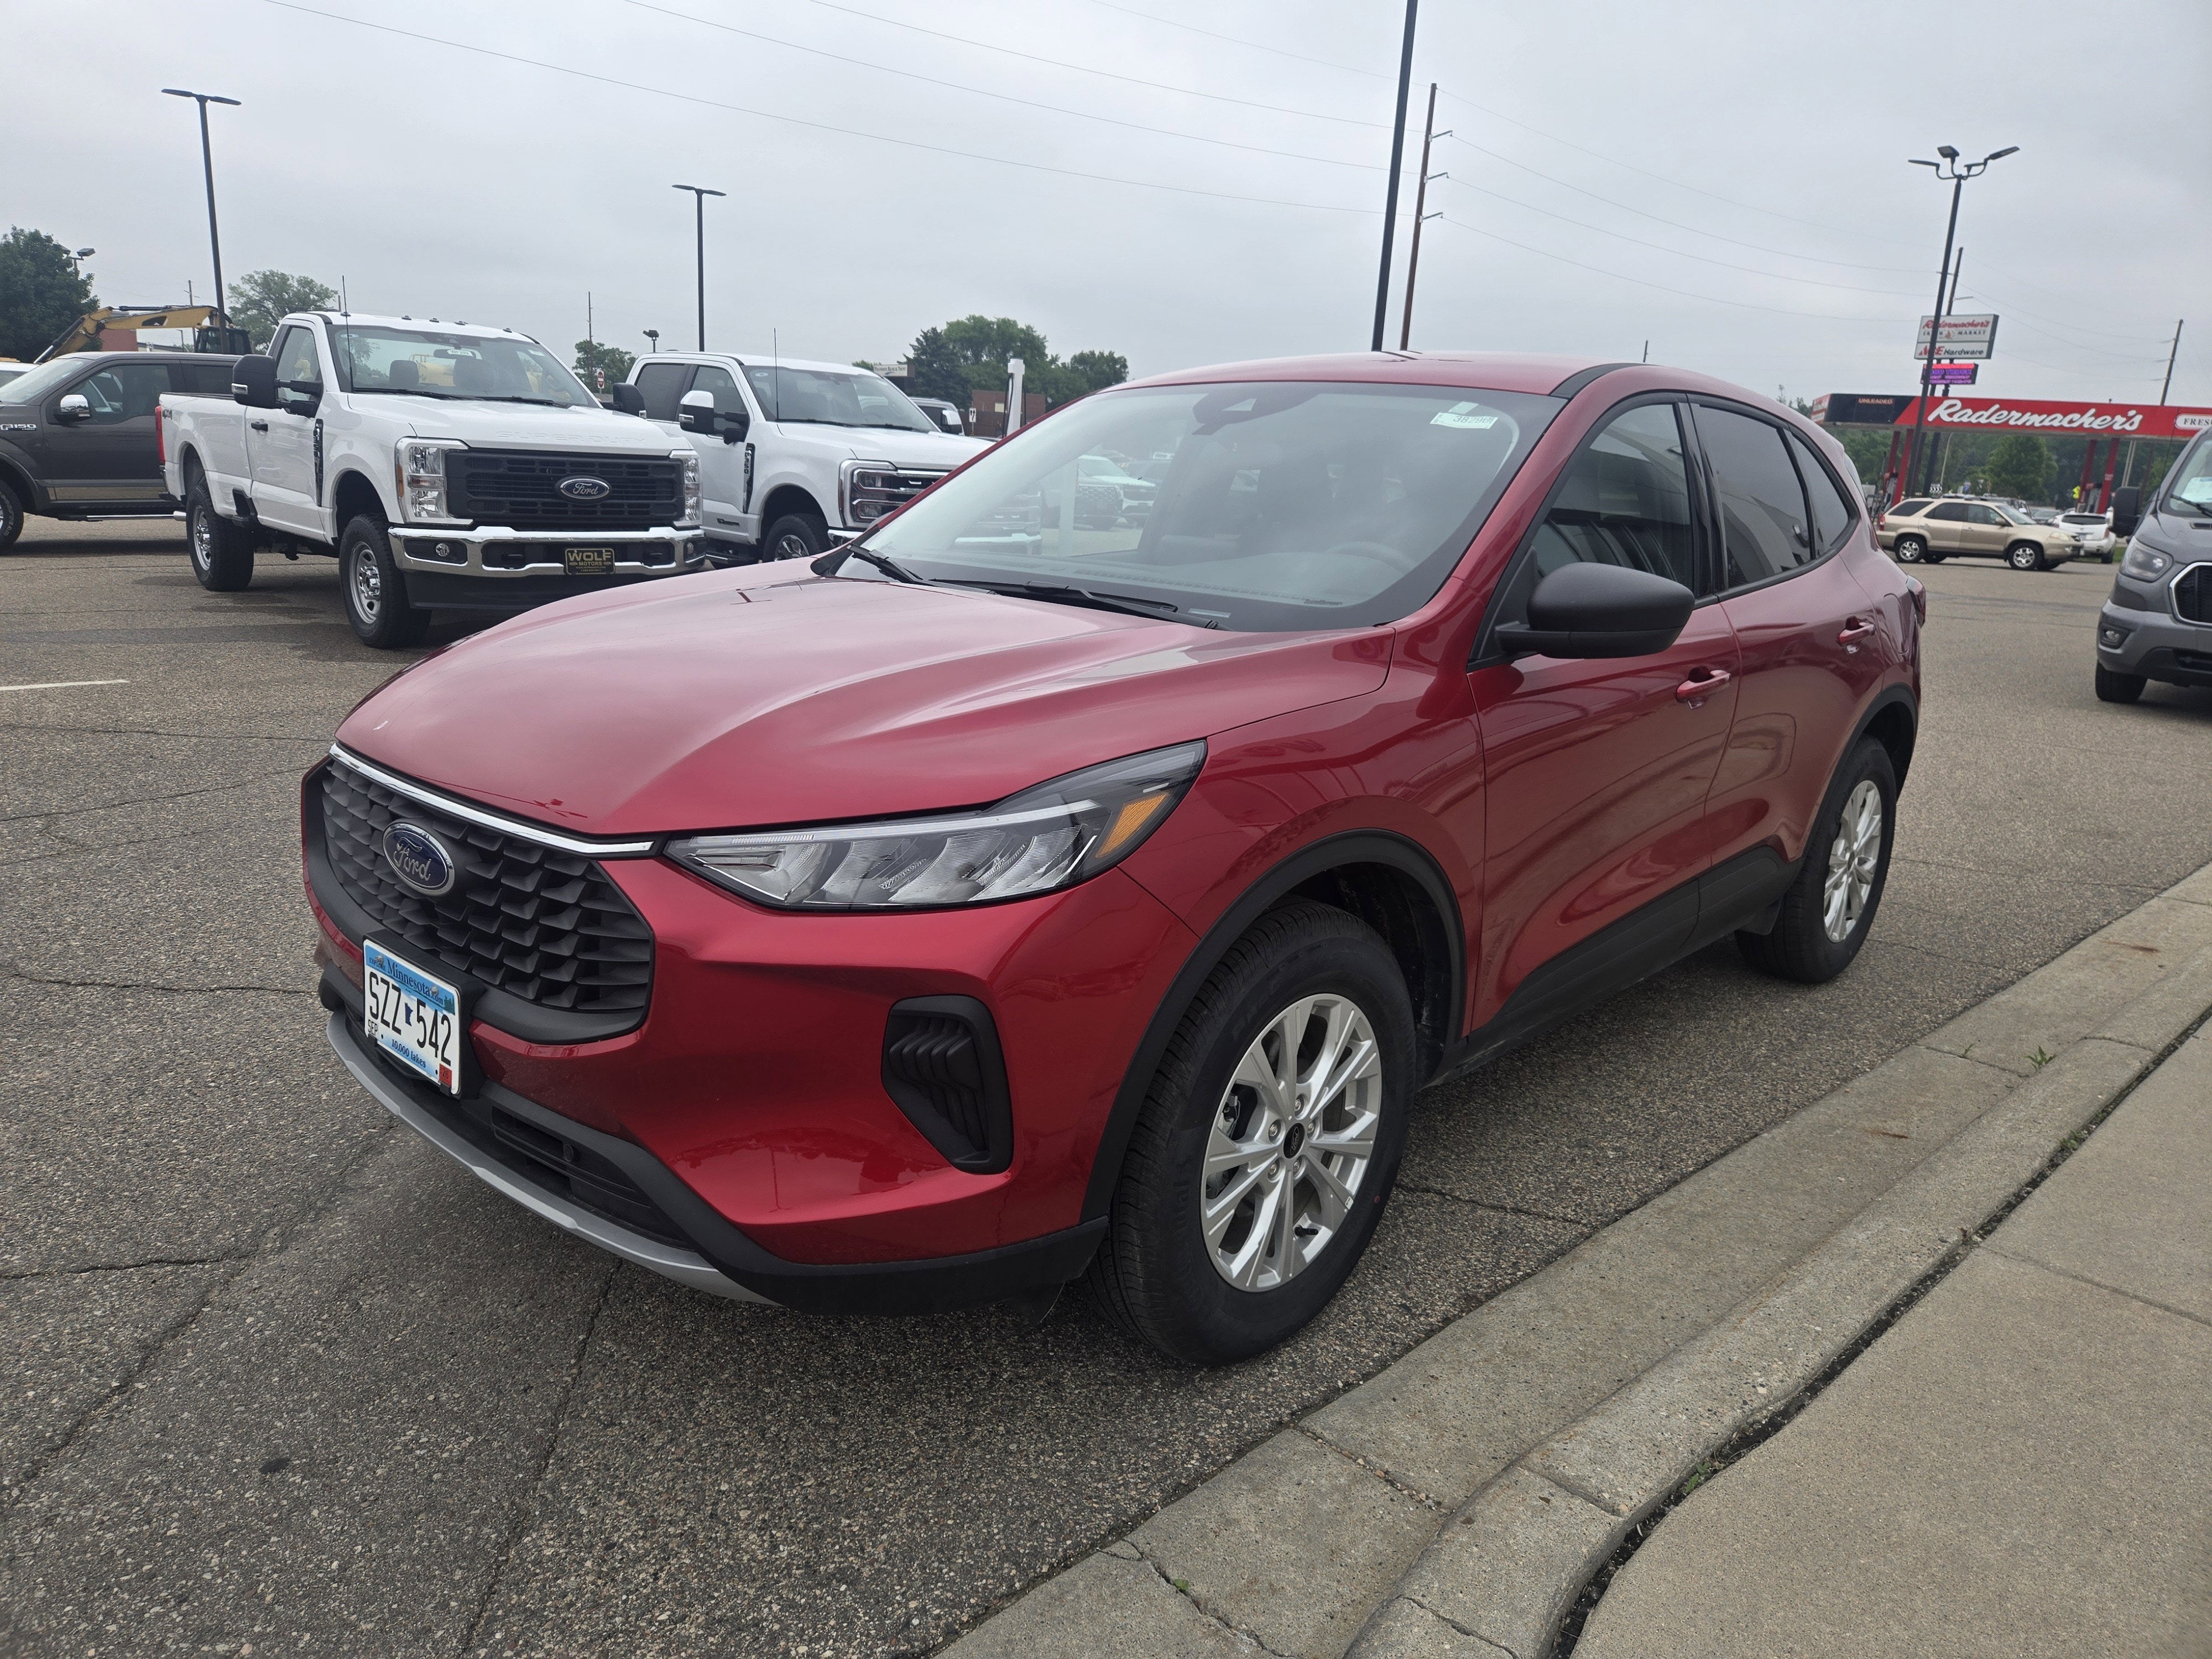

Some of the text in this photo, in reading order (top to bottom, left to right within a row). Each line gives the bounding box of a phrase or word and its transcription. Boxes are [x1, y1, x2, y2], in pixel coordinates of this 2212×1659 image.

[1923, 320, 1990, 328] Rdermacher's
[1928, 399, 2143, 431] Radermacher's
[2183, 418, 2212, 426] FRES
[572, 482, 599, 495] Ford
[568, 552, 612, 561] WOLF
[393, 836, 432, 881] Ford
[368, 1019, 378, 1036] SEP
[369, 971, 451, 1067] SZZ 542
[392, 1039, 426, 1068] 10,000 lakes
